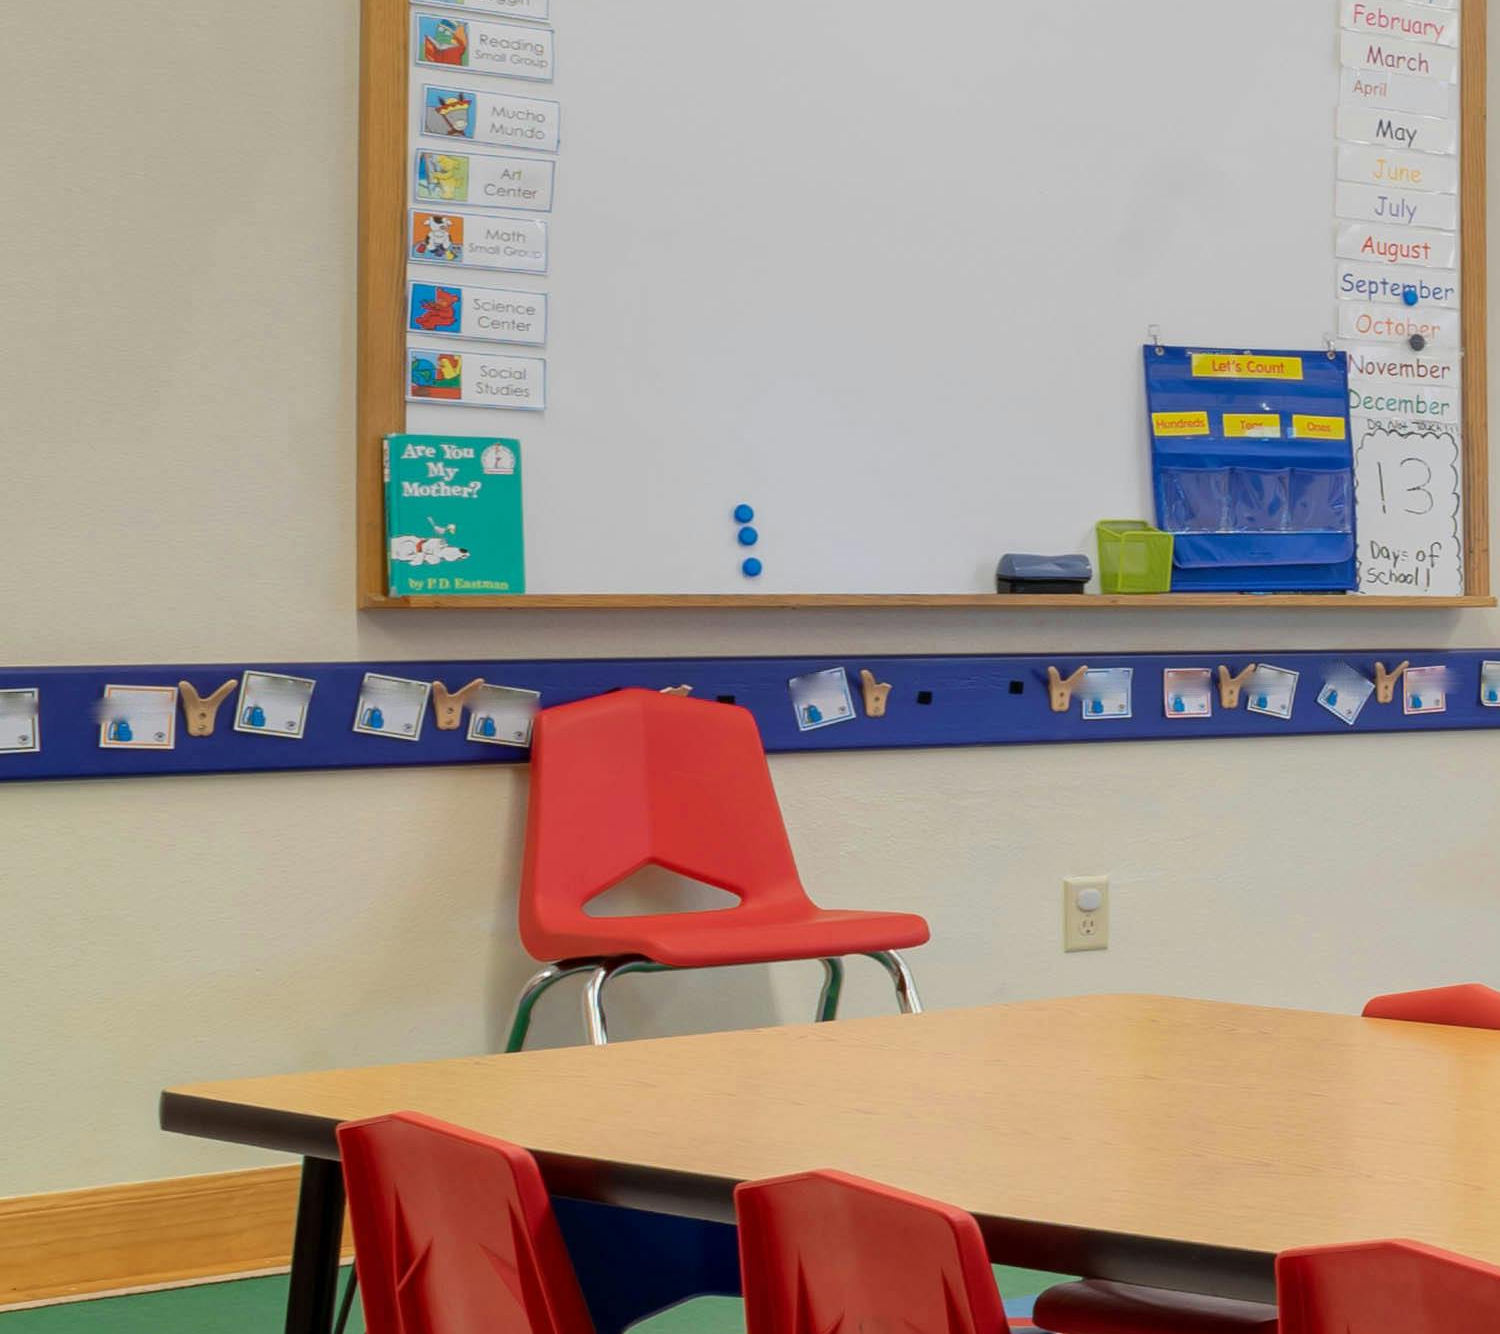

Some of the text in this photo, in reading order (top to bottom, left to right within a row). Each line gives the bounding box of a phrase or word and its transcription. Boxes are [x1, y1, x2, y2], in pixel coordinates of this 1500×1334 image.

[1353, 3, 1444, 44] February
[479, 33, 544, 55] Reading
[475, 50, 548, 69] Small Group
[1366, 45, 1430, 74] March
[1353, 80, 1387, 97] April
[492, 106, 545, 123] Mucho
[490, 123, 545, 140] Mundo
[1376, 119, 1417, 148] May
[500, 168, 522, 181] Art
[1372, 159, 1423, 184] June
[484, 183, 538, 200] Center
[1374, 195, 1417, 224] July
[484, 228, 526, 244] Math
[469, 243, 543, 260] Small Group
[1361, 235, 1432, 263] August
[472, 298, 536, 316] Science
[478, 315, 531, 332] Center
[1355, 314, 1441, 339] October
[480, 365, 527, 380] Social
[1212, 359, 1285, 374] Let's Count
[1349, 354, 1450, 380] November
[475, 381, 531, 398] Studies
[1349, 388, 1450, 416] December
[1156, 417, 1206, 430] Hundreds
[401, 443, 475, 460] Are You
[426, 462, 459, 481] My
[402, 481, 481, 499] Mother?
[1377, 457, 1434, 515] 13
[1416, 541, 1442, 568] of
[408, 578, 424, 591] by
[455, 578, 509, 591] Eastman
[1366, 567, 1431, 592] School!
